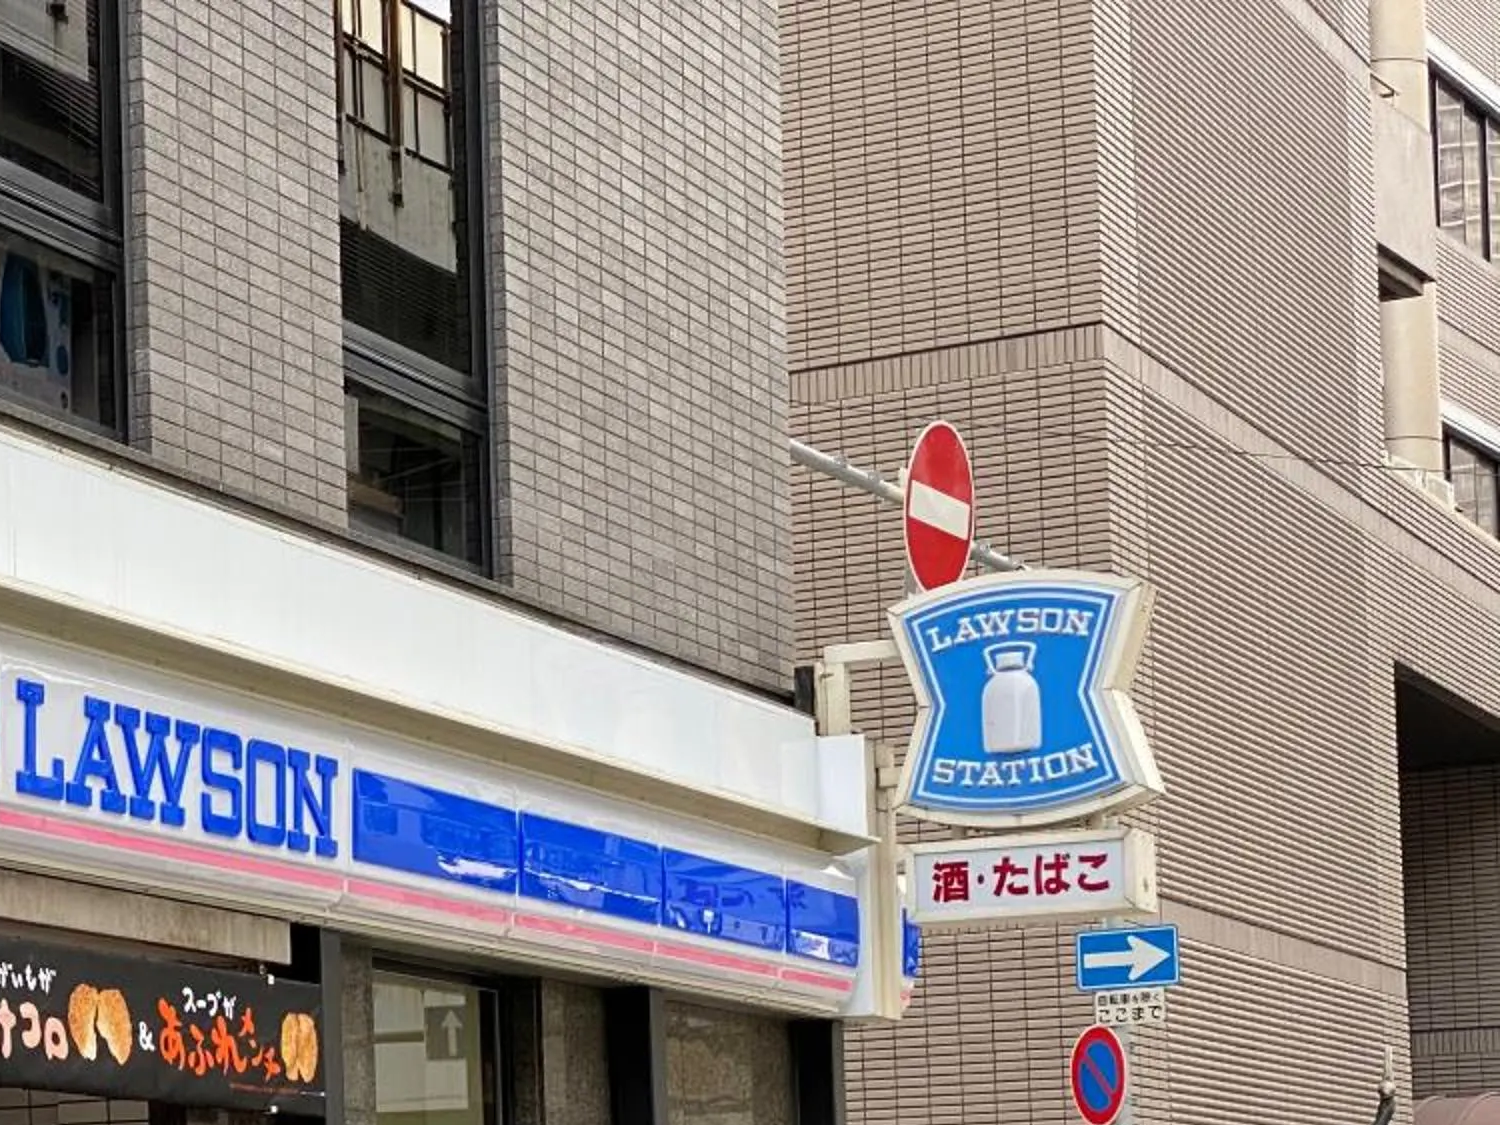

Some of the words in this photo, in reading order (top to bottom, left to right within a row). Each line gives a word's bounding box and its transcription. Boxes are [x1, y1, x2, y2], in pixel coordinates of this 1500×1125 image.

[927, 608, 1094, 652] LAWSON
[16, 678, 339, 858] LAWSON
[932, 743, 1098, 787] STATION
[138, 1020, 156, 1052] &
[1098, 1005, 1162, 1023] ここまで
